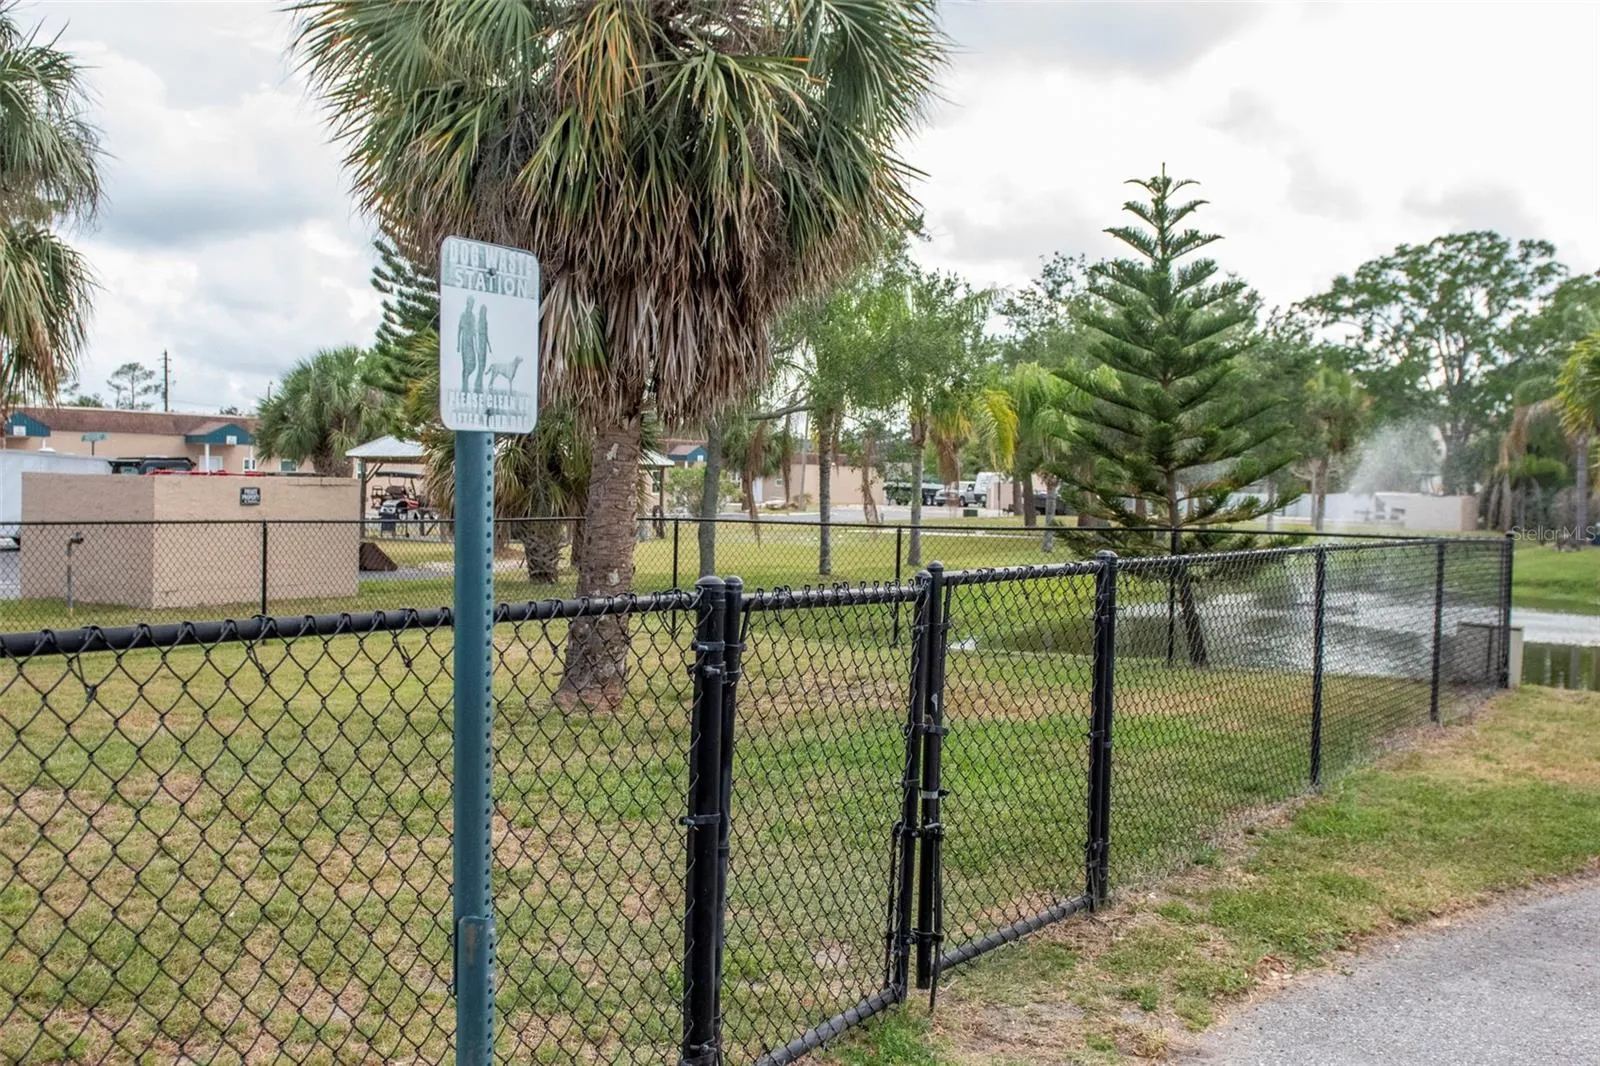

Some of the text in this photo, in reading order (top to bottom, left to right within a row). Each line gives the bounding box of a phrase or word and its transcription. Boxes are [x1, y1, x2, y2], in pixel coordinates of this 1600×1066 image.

[449, 241, 534, 277] DOG WASTE
[455, 269, 527, 298] STATION
[449, 391, 484, 409] PLEASE
[487, 394, 516, 409] CLEAN
